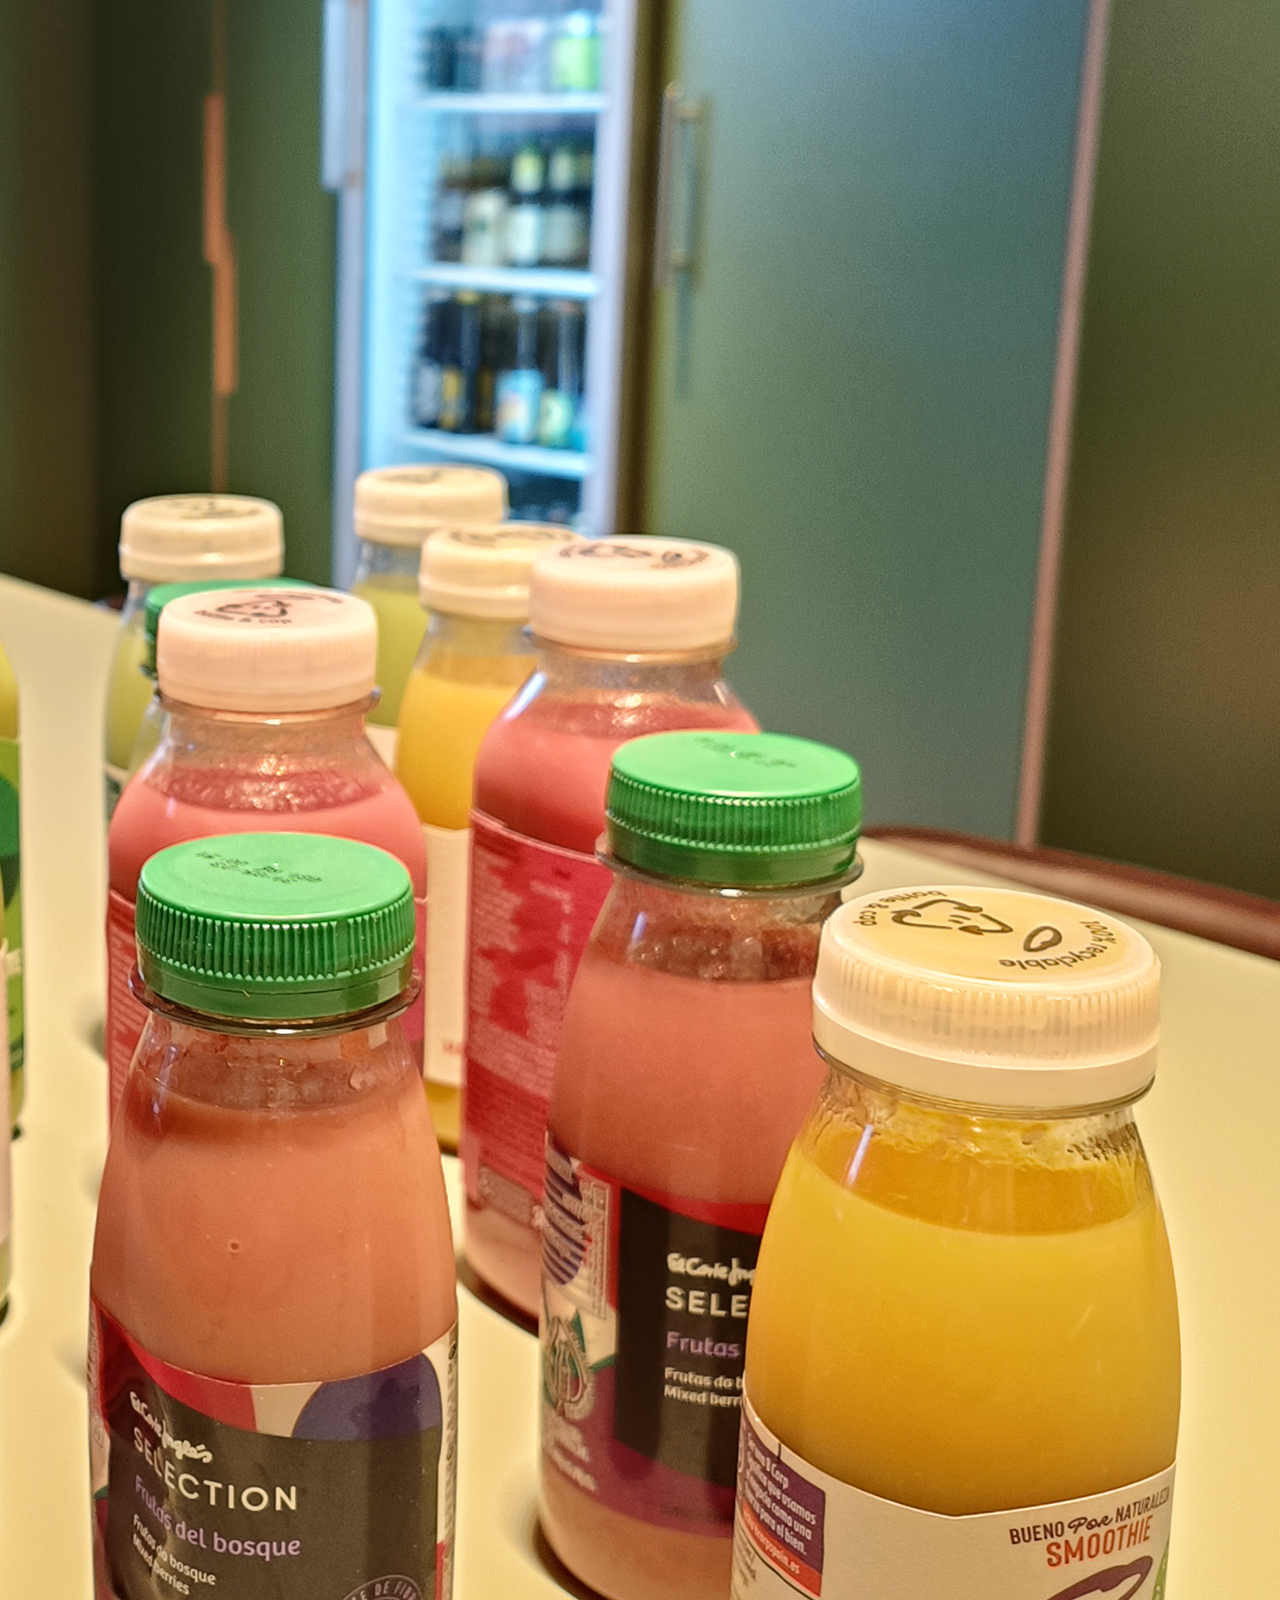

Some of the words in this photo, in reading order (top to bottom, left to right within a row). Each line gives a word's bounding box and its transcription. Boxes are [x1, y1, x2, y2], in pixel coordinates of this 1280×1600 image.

[879, 890, 948, 903] bottle
[852, 910, 877, 927] cap
[1079, 920, 1118, 945] 100%
[998, 943, 1108, 971] recyclable
[666, 1331, 741, 1358] Frutas
[664, 1366, 713, 1388] Frutas
[714, 1375, 733, 1390] do
[664, 1384, 707, 1406] Mixed
[133, 1427, 297, 1512] SELECTION
[771, 1462, 790, 1490] Corp
[767, 1479, 782, 1501] que
[781, 1490, 817, 1526] usamos
[135, 1474, 172, 1531] Frutas
[175, 1520, 207, 1549] del
[213, 1531, 301, 1562] bosque
[771, 1500, 793, 1528] como
[793, 1520, 813, 1541] una
[784, 1526, 807, 1556] bien.
[1009, 1521, 1065, 1545] BUENO
[1045, 1514, 1154, 1568] SMOOTHIE
[153, 1559, 190, 1596] berries
[170, 1553, 217, 1586] bosque
[374, 1580, 390, 1597] DE
